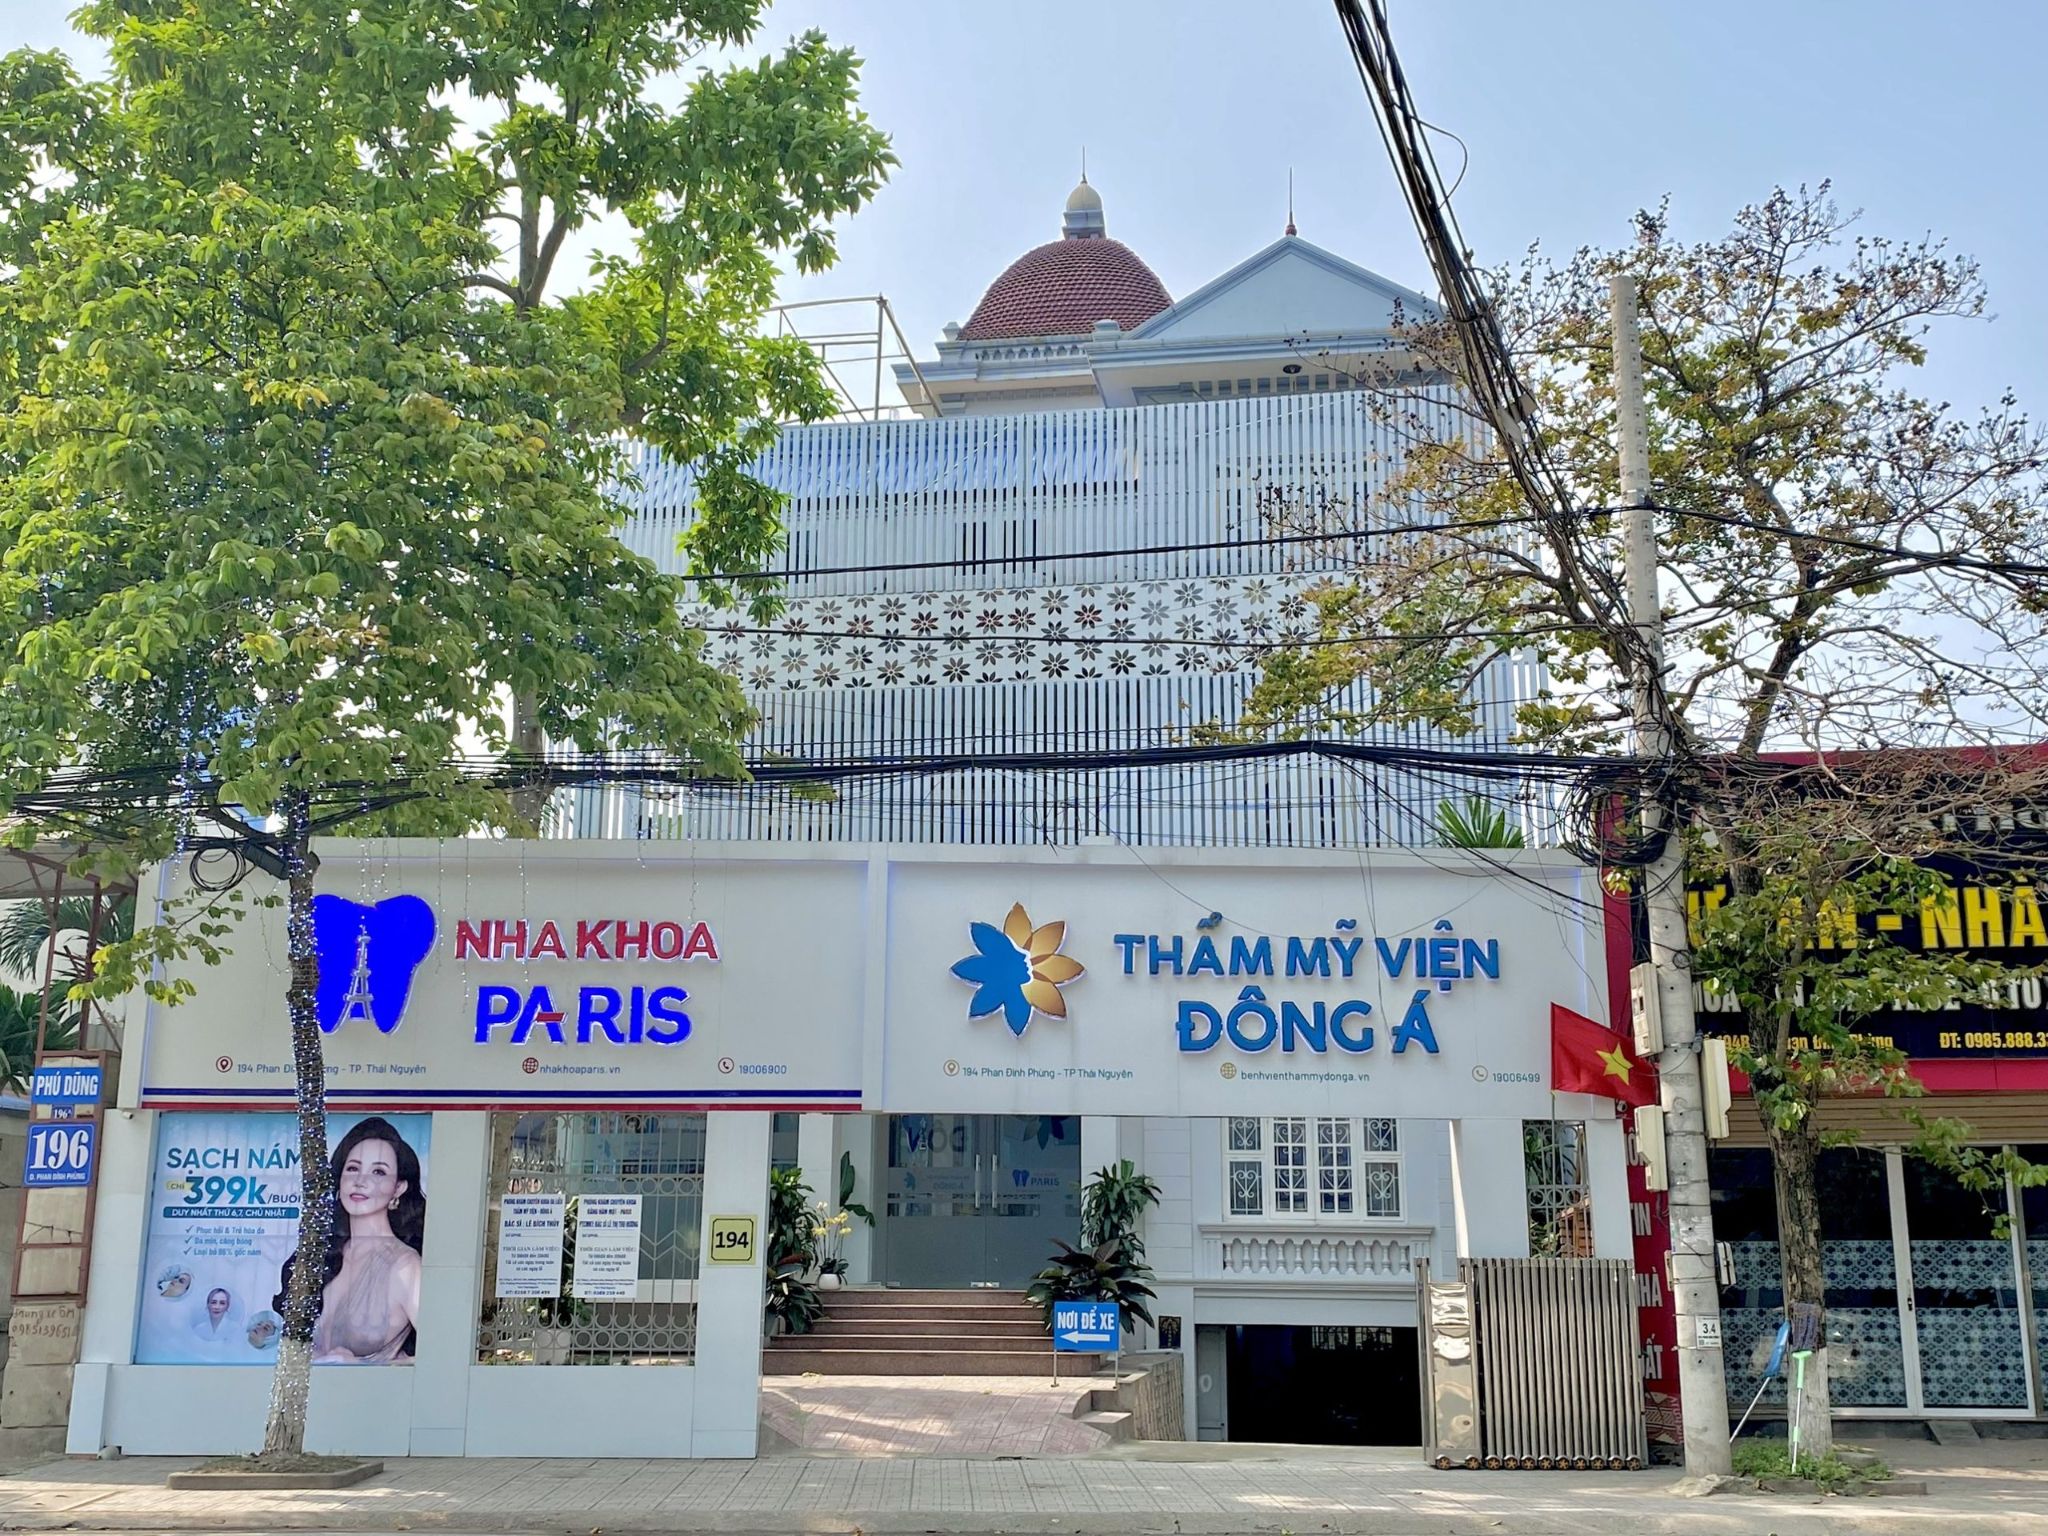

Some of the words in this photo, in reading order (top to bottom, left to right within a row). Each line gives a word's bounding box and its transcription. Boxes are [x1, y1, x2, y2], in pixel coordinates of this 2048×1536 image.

[455, 919, 568, 960] NHA
[576, 919, 720, 960] KHOA
[1113, 911, 1274, 977] THẨM
[1285, 918, 1363, 978] MỸ
[1375, 919, 1500, 992] VIỆN
[475, 985, 692, 1045] PARIS
[1175, 985, 1374, 1054] ĐÔNG
[1392, 989, 1440, 1054] Á
[1940, 1032, 1961, 1049] ĐT:
[237, 1063, 253, 1073] 194
[256, 1063, 280, 1073] Phan
[390, 1063, 426, 1076] Nguyên
[539, 1064, 621, 1075] nhakhoaparis.vn
[738, 1064, 787, 1075] 19006900
[962, 1067, 978, 1077] 194
[981, 1067, 1003, 1078] Phan
[1098, 1068, 1133, 1081] Nguyên
[36, 1071, 62, 1096] PHÚ
[64, 1071, 98, 1096] DŨNG
[1240, 1071, 1370, 1083] benhvienthammydonga.vn
[1492, 1072, 1541, 1083] 19006499
[30, 1129, 89, 1169] 196
[167, 1147, 240, 1175] SẠCH
[183, 1176, 268, 1205] 399k
[1030, 1178, 1060, 1187] PARIS
[172, 1208, 189, 1217] DUY
[715, 1231, 749, 1249] 194
[1057, 1310, 1078, 1330] NƠI
[1081, 1305, 1097, 1330] ĐỂ
[1099, 1313, 1115, 1330] XE
